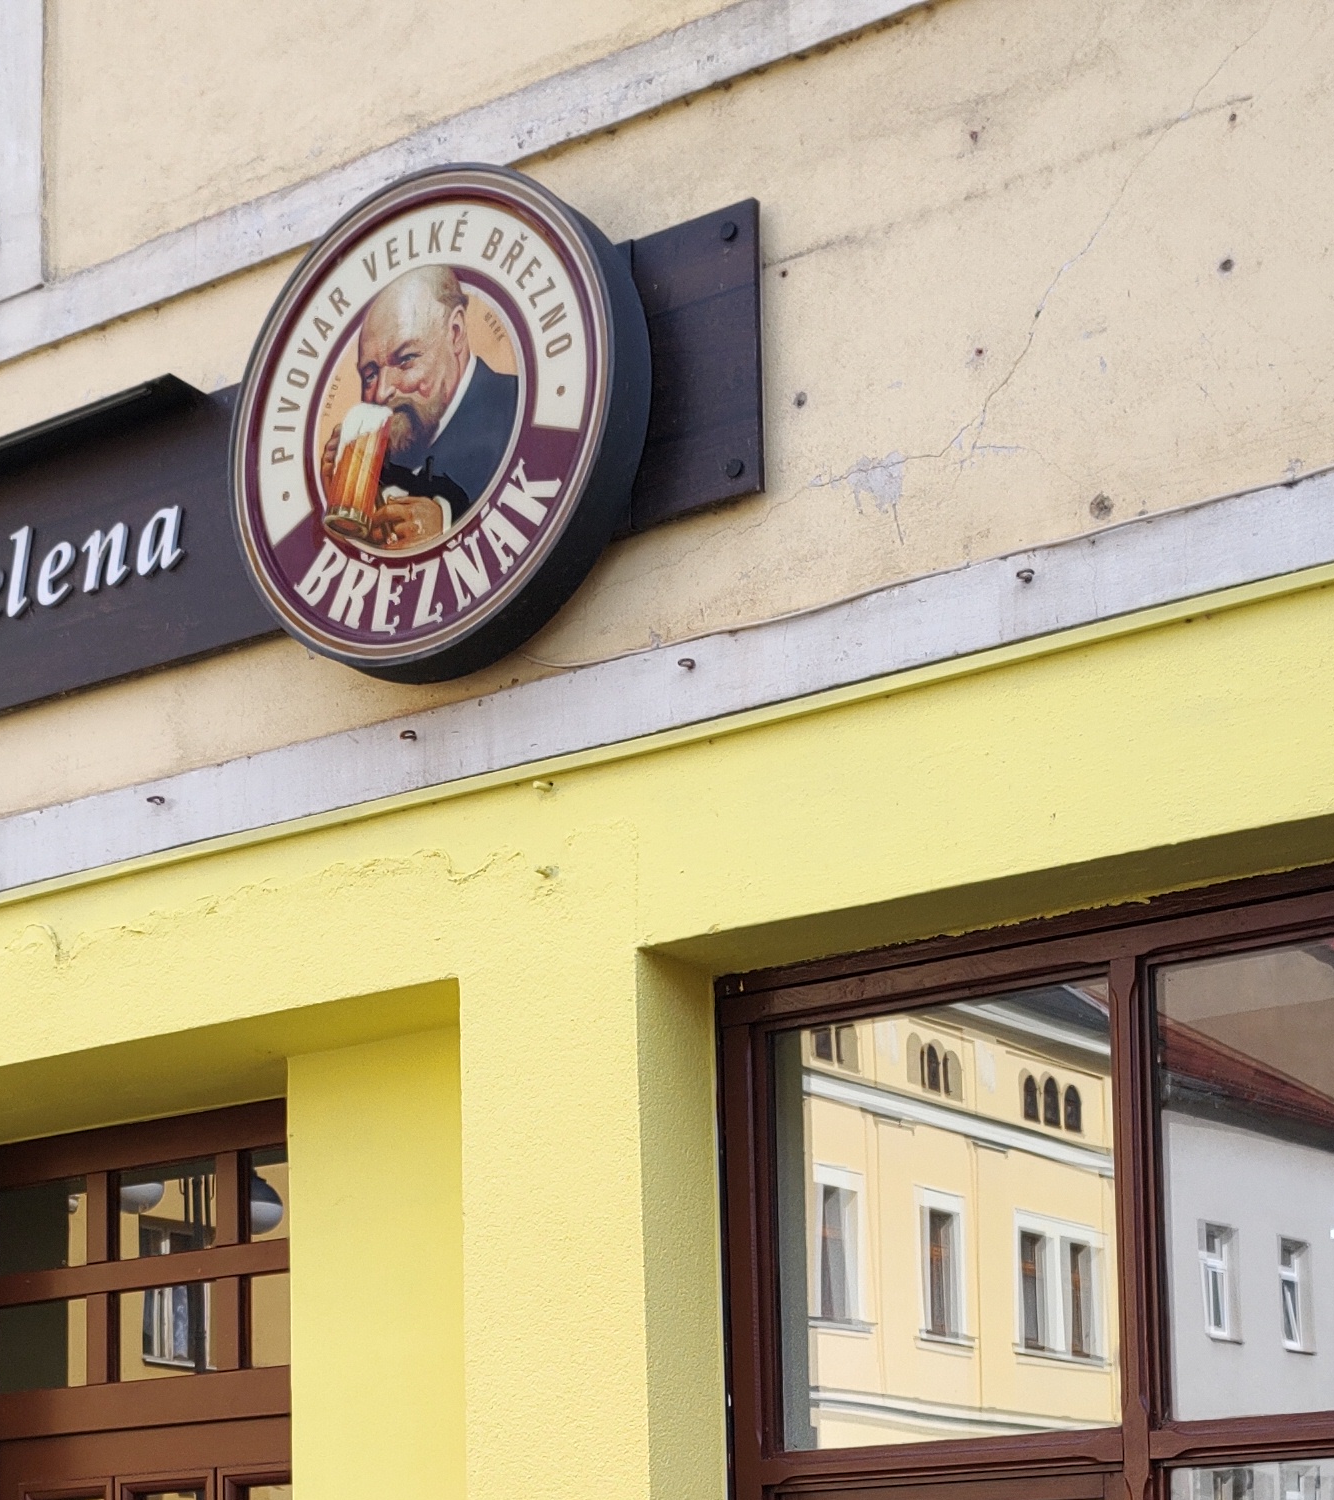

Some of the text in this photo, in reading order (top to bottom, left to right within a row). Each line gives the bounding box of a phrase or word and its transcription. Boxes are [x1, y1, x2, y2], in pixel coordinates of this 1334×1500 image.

[271, 211, 573, 465] PIVOVAR VELKÉ BŘEZNO
[294, 458, 563, 636] BŘEZŇÁK
